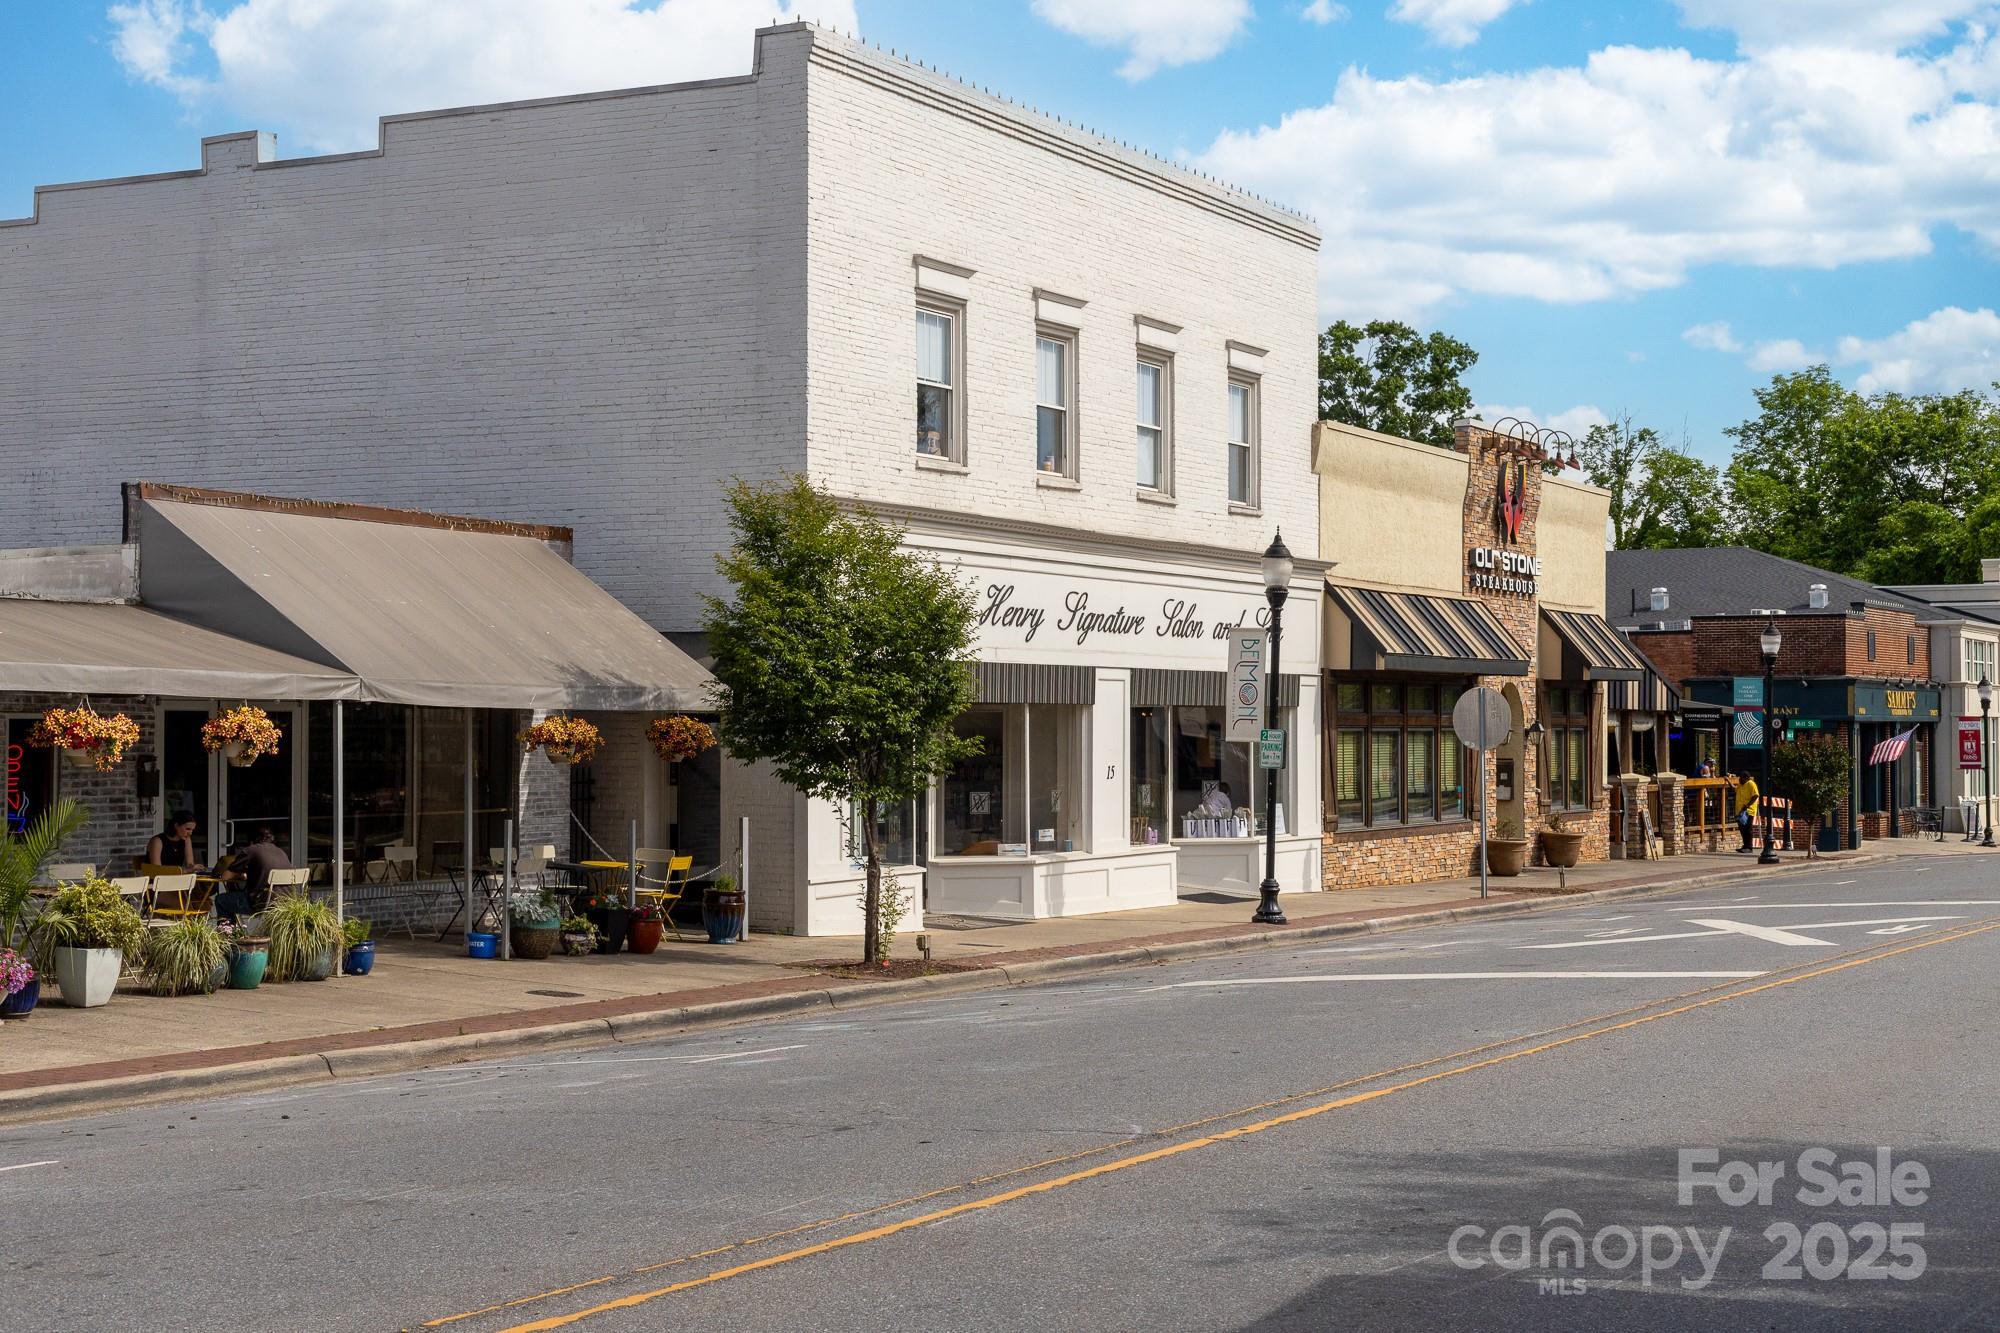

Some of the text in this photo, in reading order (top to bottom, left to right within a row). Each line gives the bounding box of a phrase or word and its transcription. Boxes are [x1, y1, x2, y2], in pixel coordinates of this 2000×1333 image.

[1501, 551, 1542, 576] STONE
[1475, 573, 1540, 594] STEAKHOUSE
[979, 584, 1046, 643] Henry
[1056, 591, 1145, 646] Signature
[1155, 598, 1204, 640] Salon
[1212, 609, 1247, 641] and
[1887, 690, 1917, 709] SAMMY'S
[1262, 731, 1268, 740] 2
[1261, 742, 1282, 753] PARKING
[1106, 765, 1116, 780] 15
